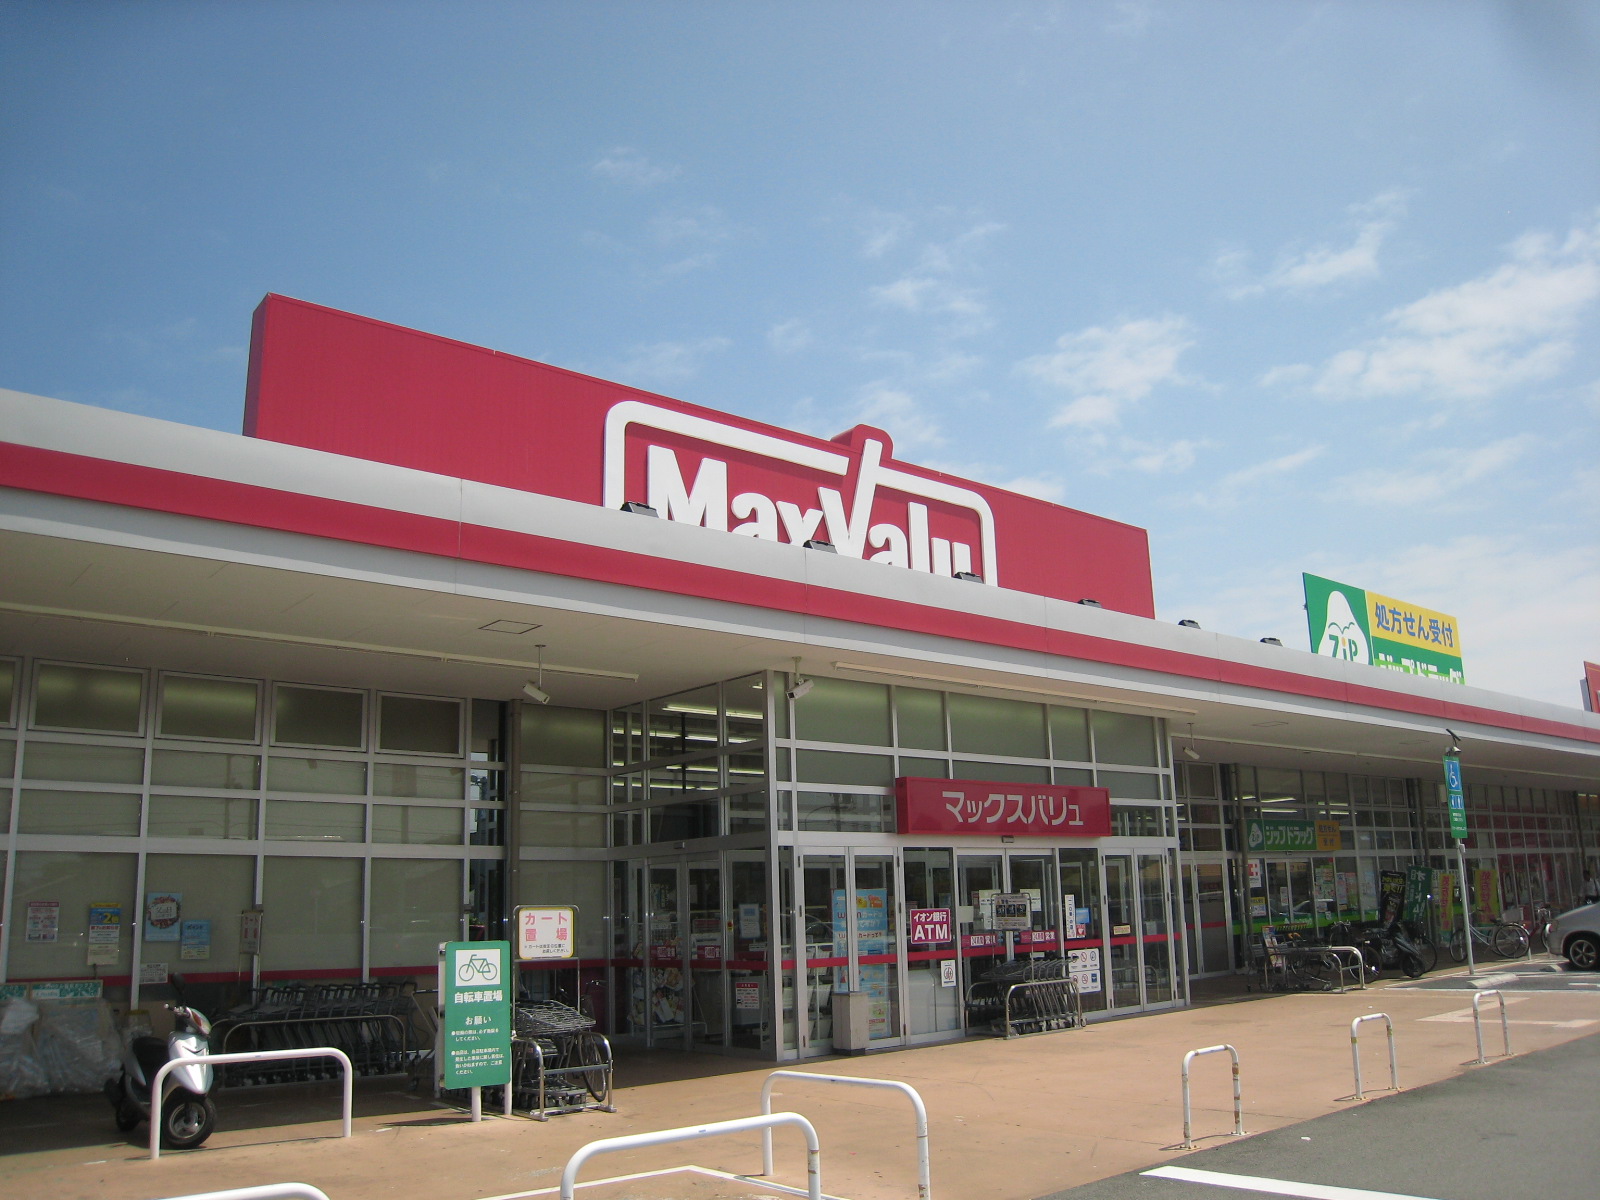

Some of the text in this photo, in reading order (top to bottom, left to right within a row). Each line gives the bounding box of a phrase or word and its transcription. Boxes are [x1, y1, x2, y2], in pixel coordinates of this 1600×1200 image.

[1375, 602, 1454, 648] 処方せん受付
[942, 791, 1084, 825] マックスバリュ
[525, 911, 568, 926] カート
[914, 911, 947, 922] イオン銀行
[525, 927, 568, 942] 置場
[914, 924, 948, 940] ATM
[454, 990, 503, 1004] 自転車置場
[465, 1015, 492, 1026] お願い
